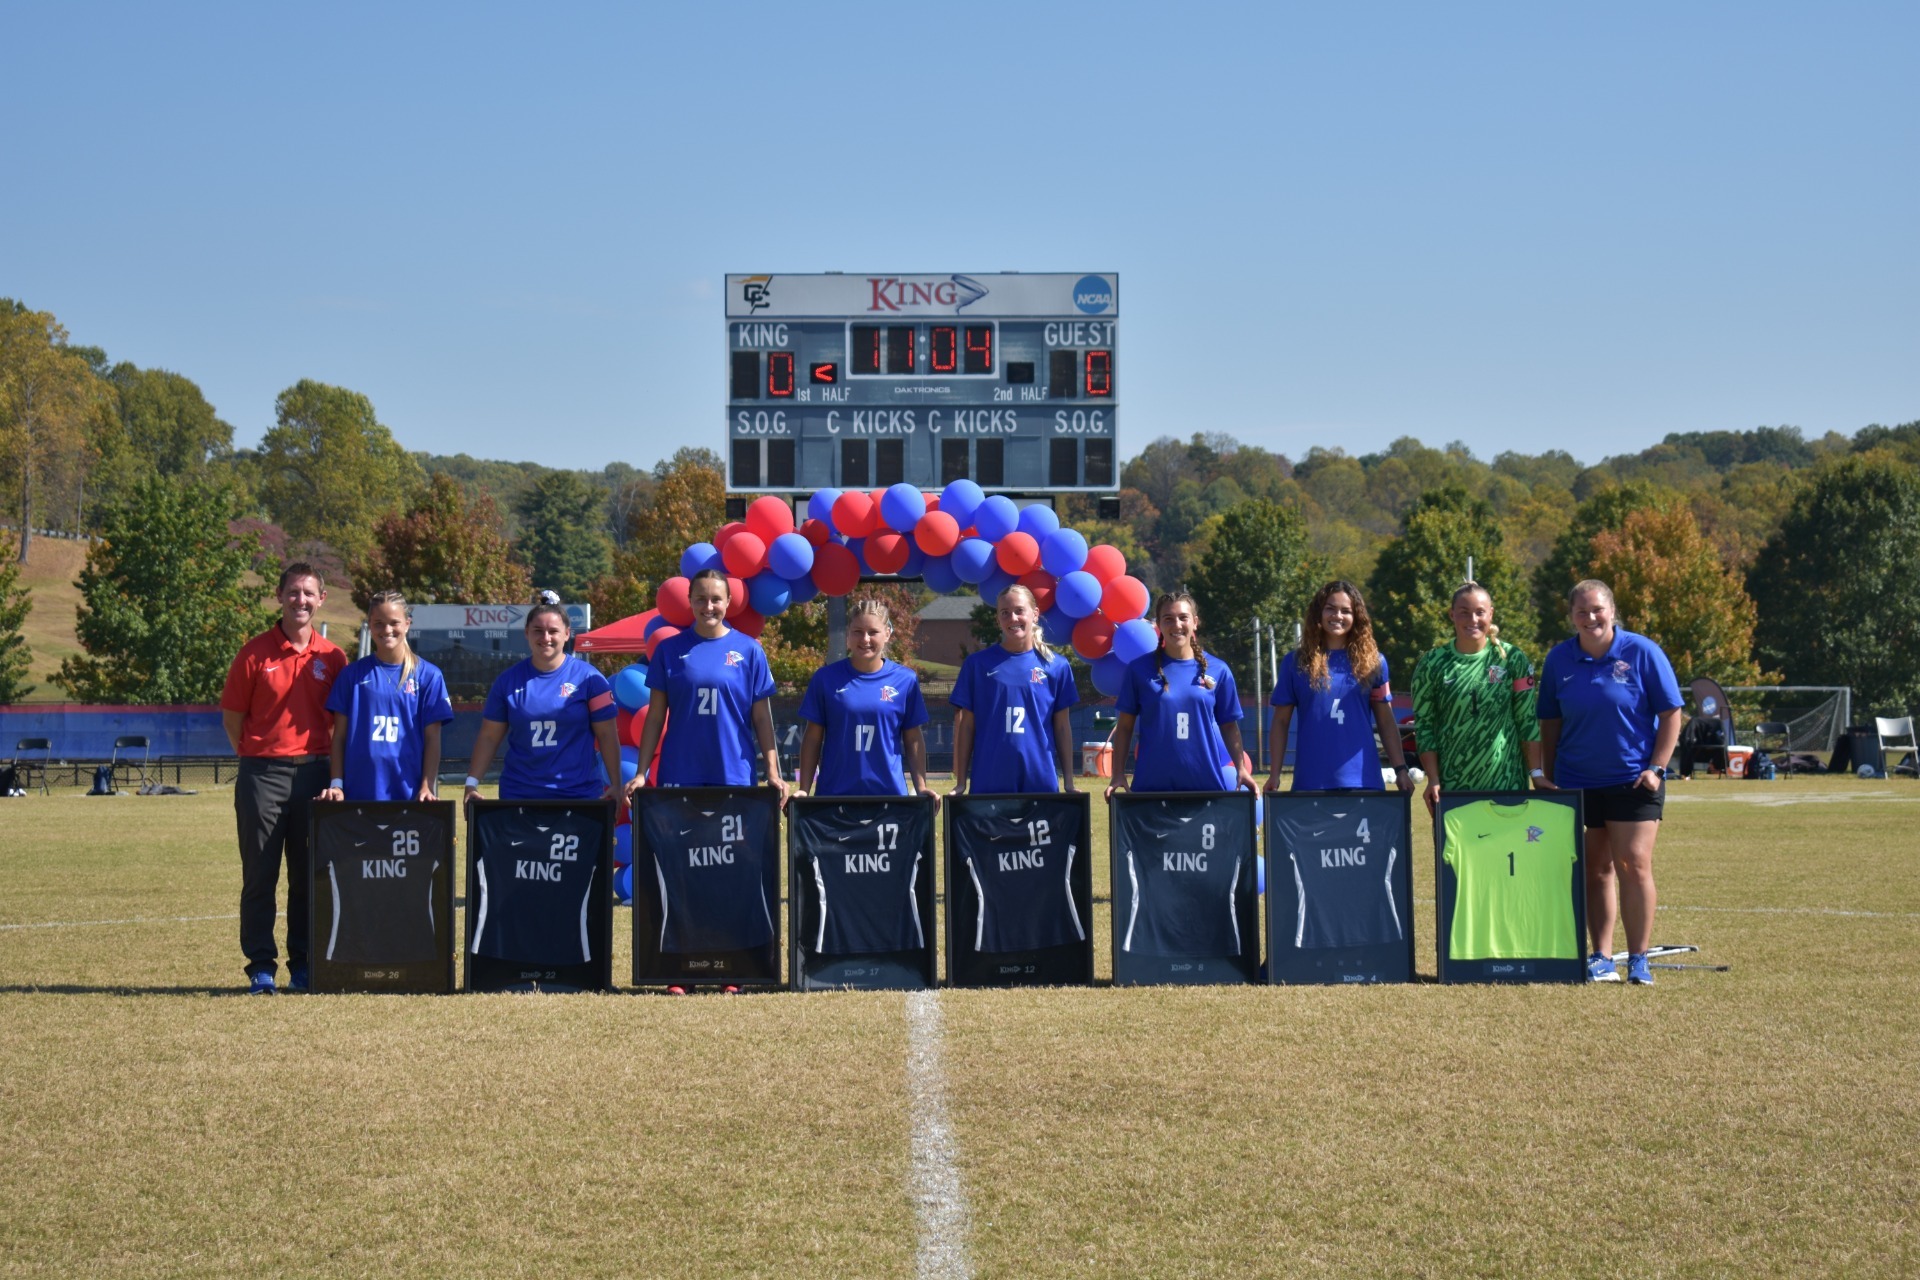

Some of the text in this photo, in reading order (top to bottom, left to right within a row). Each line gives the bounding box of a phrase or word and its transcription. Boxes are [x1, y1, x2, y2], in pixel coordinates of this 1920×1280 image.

[867, 278, 958, 311] KING
[1077, 293, 1111, 305] NCAA
[739, 323, 789, 347] KING
[1044, 322, 1114, 346] GUEST
[873, 327, 990, 370] 11:04
[769, 352, 793, 395] 0
[1086, 351, 1110, 394] 0
[797, 387, 851, 402] 1st HALF
[894, 386, 951, 394] DAKTRONICS
[993, 386, 1048, 401] 2nd HALF
[737, 411, 791, 434] S.O.G.
[827, 411, 916, 434] C KICKS
[928, 410, 1017, 433] C KICKS
[1054, 410, 1108, 433] S.O.G.
[464, 608, 509, 627] KING
[448, 630, 466, 639] BALL
[484, 630, 508, 639] STRIKE
[698, 688, 717, 715] 21
[1330, 698, 1345, 724] 4
[372, 716, 399, 742] 26
[1006, 707, 1025, 734] 12
[1176, 713, 1189, 740] 8
[530, 721, 557, 747] 22
[855, 725, 875, 752] 17
[1729, 757, 1744, 773] G
[721, 814, 744, 842] 21
[877, 824, 899, 850] 17
[1028, 820, 1051, 846] 12
[1202, 824, 1215, 850] 8
[1356, 818, 1370, 843] 4
[392, 830, 420, 856] 26
[550, 833, 579, 861] 22
[689, 845, 735, 867] KING
[845, 853, 890, 873] KING
[998, 848, 1044, 872] KING
[1163, 852, 1208, 872] KING
[1320, 846, 1366, 868] KING
[1507, 852, 1515, 876] 1
[362, 859, 407, 879] KING
[515, 860, 562, 882] KING
